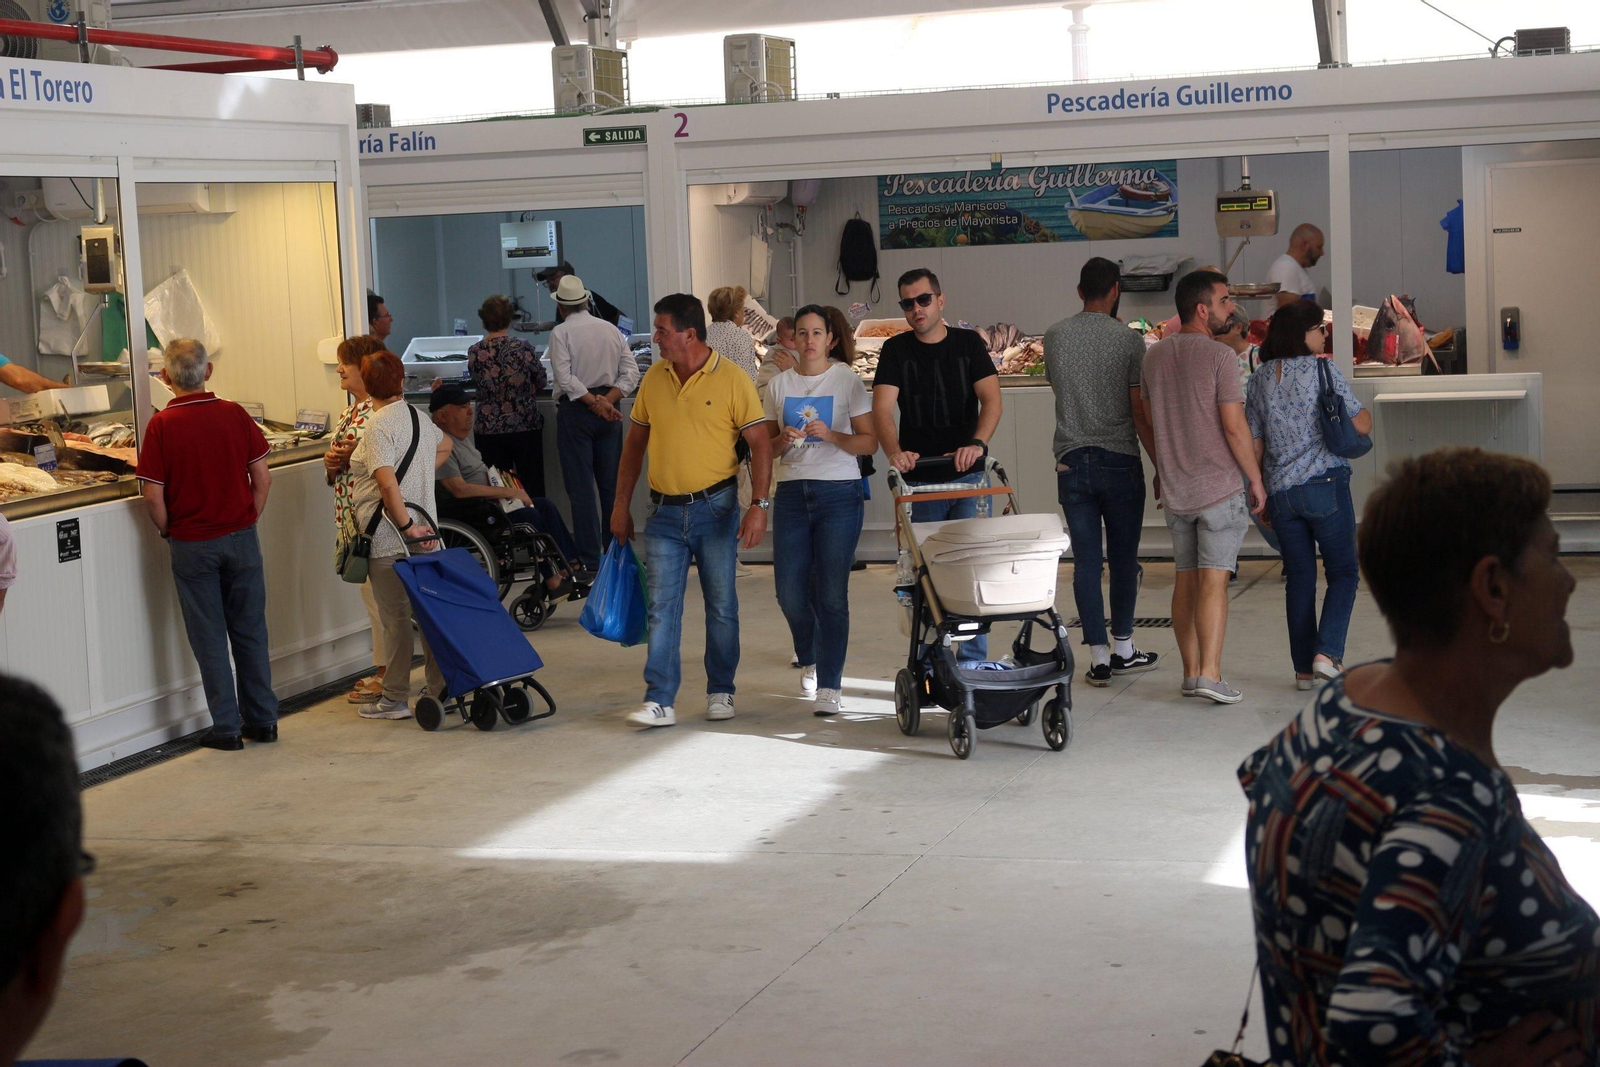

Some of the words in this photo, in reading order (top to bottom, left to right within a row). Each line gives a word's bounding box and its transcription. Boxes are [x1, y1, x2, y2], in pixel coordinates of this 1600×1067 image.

[9, 68, 28, 101] El
[30, 70, 93, 104] Torero
[1047, 86, 1170, 114] Pescadería
[1176, 82, 1293, 106] Guillermo
[605, 129, 641, 141] SALIDA
[673, 112, 690, 138] 2
[389, 131, 436, 153] Falín
[883, 169, 1022, 197] Pescadería
[1028, 163, 1159, 198] Guillermo
[888, 203, 941, 215] Pescados
[944, 204, 951, 214] y
[954, 200, 1007, 212] Mariscos
[888, 221, 895, 229] a
[899, 218, 941, 229] Precios
[944, 217, 958, 227] de
[961, 214, 1018, 228] Mayorista
